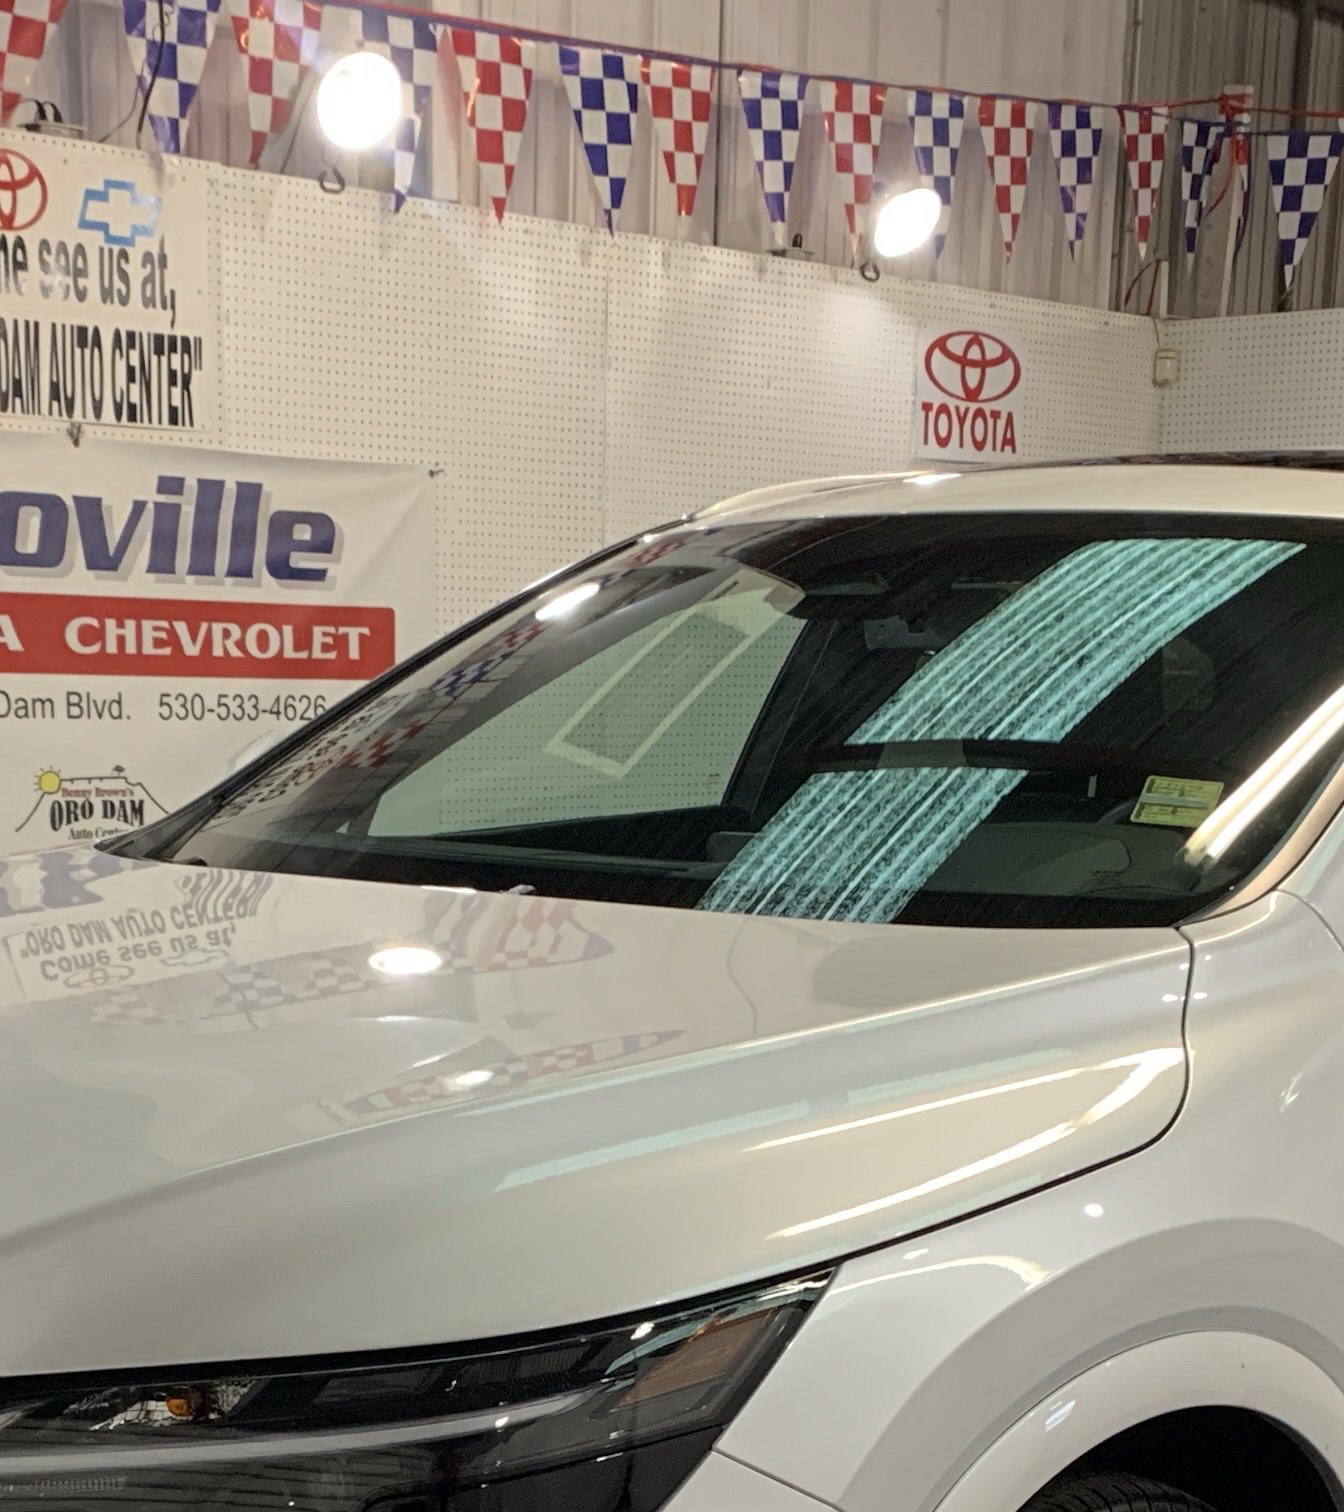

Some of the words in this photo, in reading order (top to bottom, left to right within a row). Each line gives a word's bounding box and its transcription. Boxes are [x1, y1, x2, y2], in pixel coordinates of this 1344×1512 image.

[38, 237, 89, 303] see
[98, 244, 132, 308] us
[140, 235, 177, 330] at,
[48, 321, 105, 422] AUTO
[111, 327, 203, 429] CENTER"
[921, 401, 1017, 454] TOYOTA
[64, 614, 371, 662] CHEVROLET
[66, 690, 133, 722] Blvd.
[158, 692, 327, 722] 530-533-4626
[49, 799, 94, 832] ORO
[101, 799, 145, 827] DAM
